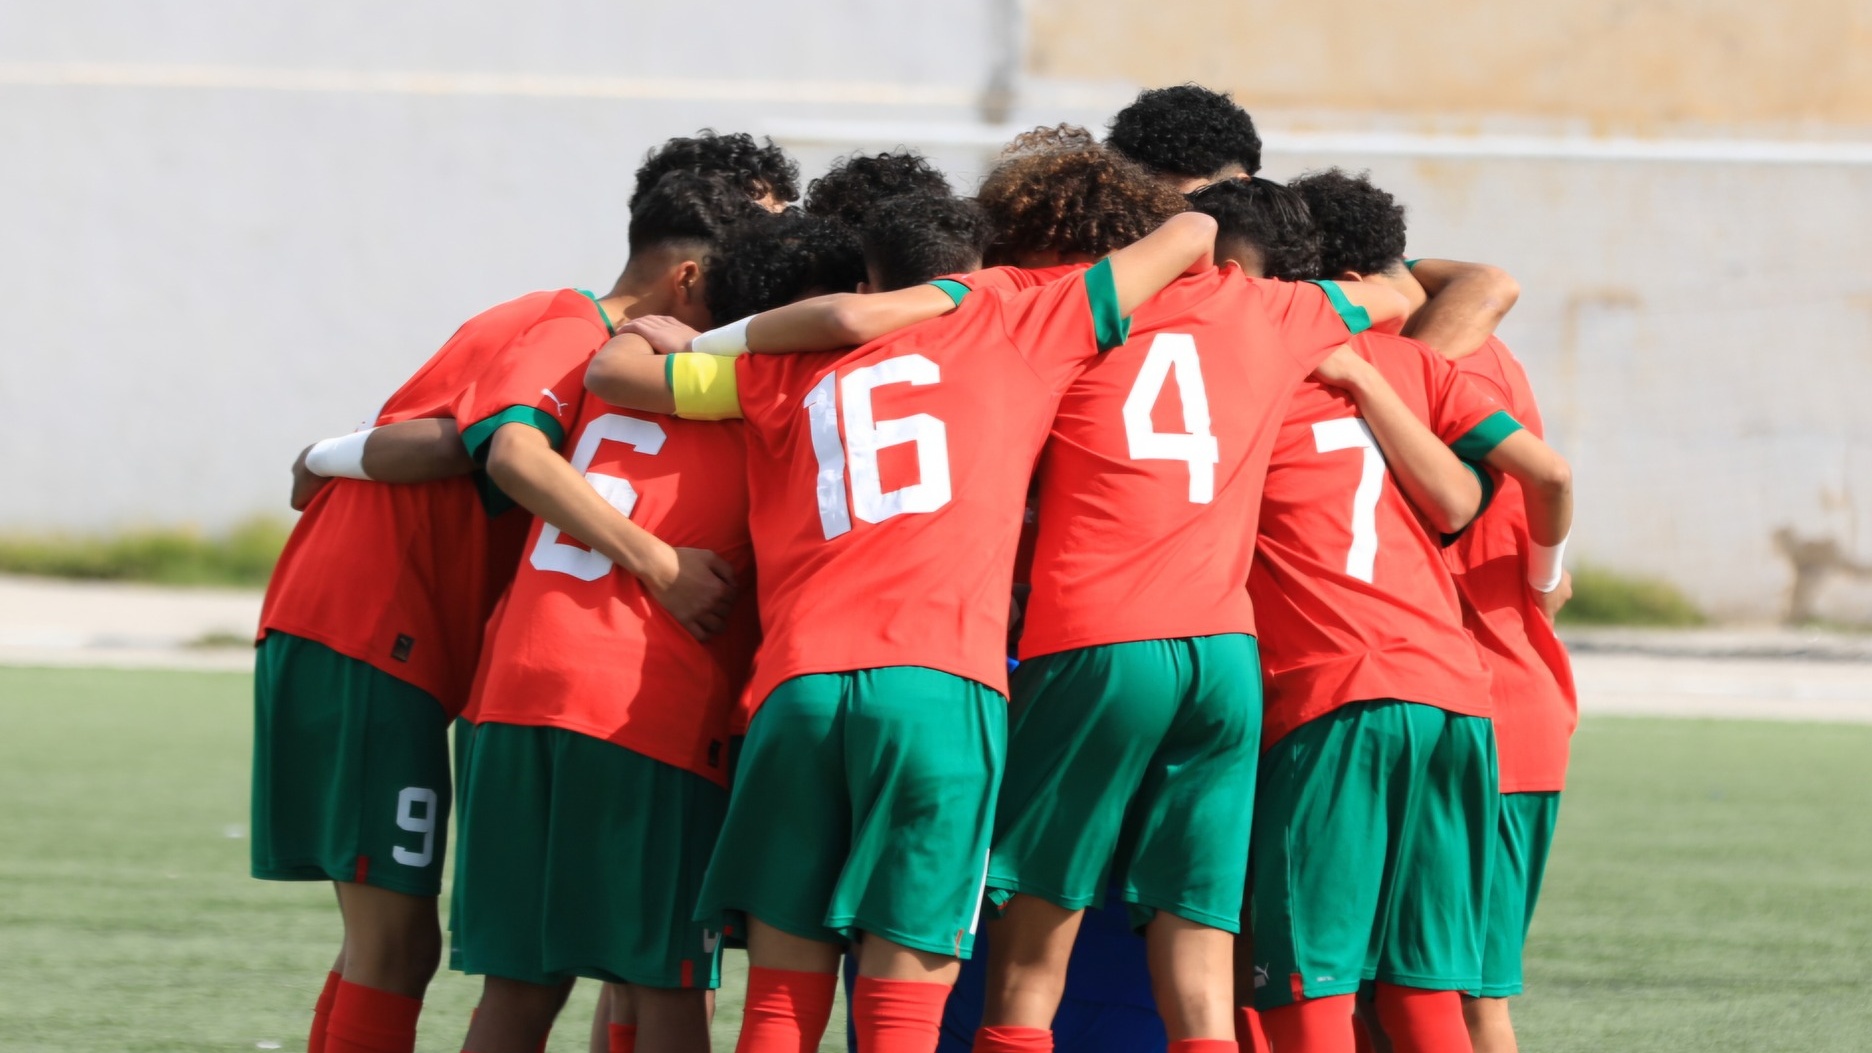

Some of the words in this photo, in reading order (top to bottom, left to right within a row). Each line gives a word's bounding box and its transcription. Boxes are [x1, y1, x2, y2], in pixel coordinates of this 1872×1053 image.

[529, 412, 668, 582] 6
[803, 353, 953, 541] 16
[1122, 333, 1220, 504] 4
[1311, 417, 1386, 584] 7
[392, 786, 438, 868] 9
